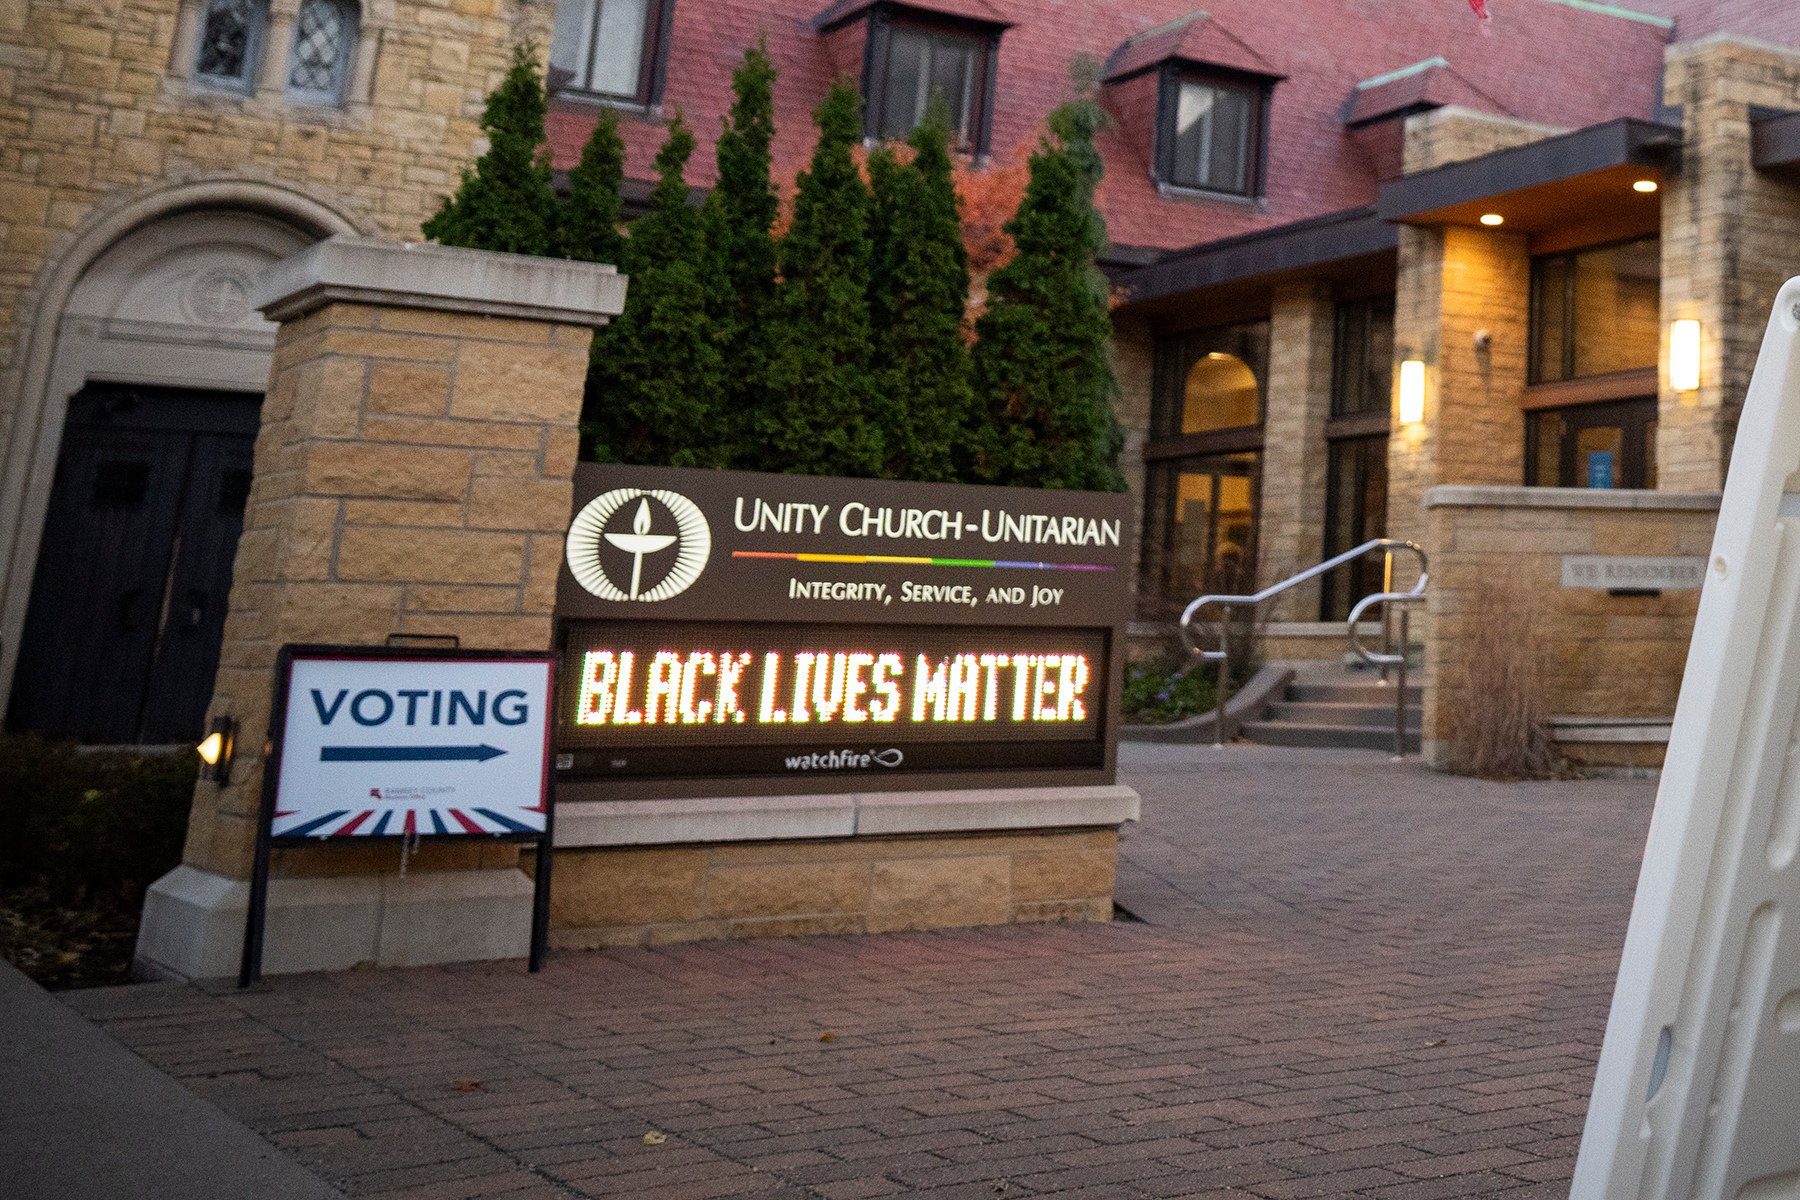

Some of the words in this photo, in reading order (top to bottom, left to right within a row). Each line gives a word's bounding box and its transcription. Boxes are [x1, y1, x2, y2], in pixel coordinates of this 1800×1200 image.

[734, 496, 829, 535] UNITY
[838, 502, 1122, 547] CHURCH-UNITARIAN
[788, 577, 893, 606] INTEGRITY,
[900, 581, 978, 607] SERVICE,
[986, 587, 1025, 605] AND
[1030, 585, 1064, 608] JOY
[575, 650, 752, 725] BLACK
[758, 651, 905, 724] LIVES
[911, 652, 1091, 723] MATTER
[310, 688, 529, 727] VOTING
[784, 749, 871, 770] watchfire
